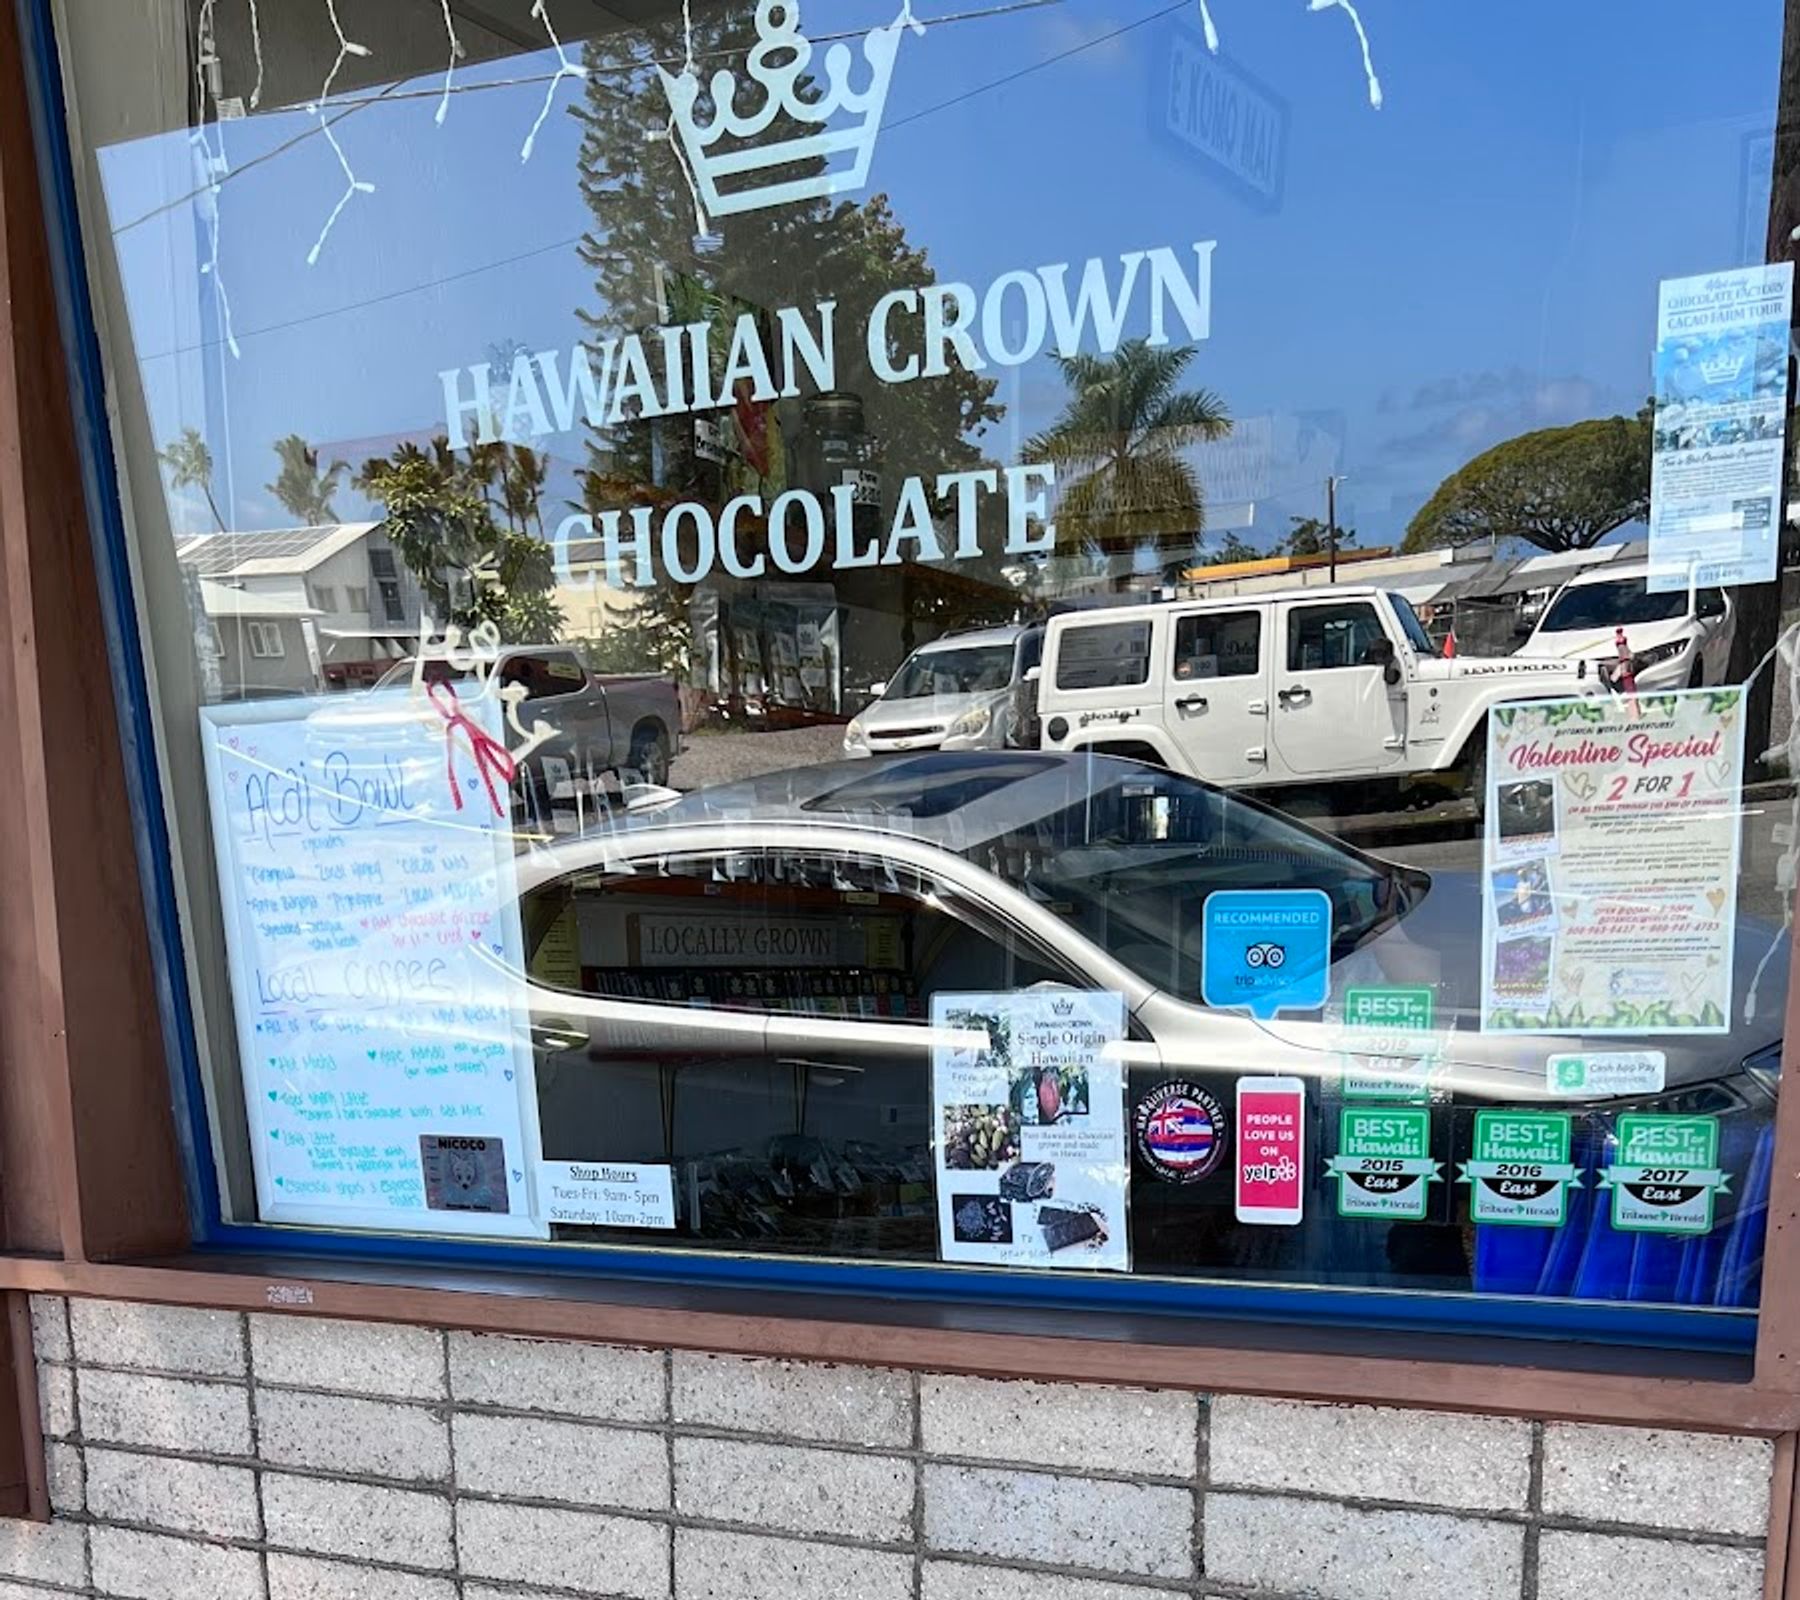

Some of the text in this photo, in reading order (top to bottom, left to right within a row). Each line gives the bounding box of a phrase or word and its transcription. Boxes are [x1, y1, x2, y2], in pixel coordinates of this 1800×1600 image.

[1667, 288, 1733, 310] CHOCOLATE
[1667, 301, 1783, 330] CACAO FARM TOUR
[438, 240, 1218, 452] HAWAIIAN CROWN
[554, 463, 1057, 591] CHOCOLATE
[1508, 731, 1722, 771] Valentine Special
[1606, 771, 1695, 802] 2 FOR 1
[1213, 911, 1321, 926] RECOMMENDED
[649, 925, 832, 956] LOCALLY GROWN
[1357, 997, 1413, 1017] BEST
[1017, 1029, 1107, 1049] Single Origin
[1031, 1050, 1094, 1065] Hawaiian
[1589, 1062, 1657, 1074] Cash App Pay
[1245, 1114, 1294, 1126] PEOPLE
[1353, 1118, 1409, 1139] BEST
[1244, 1129, 1295, 1142] LOVE US
[1489, 1121, 1545, 1143] BEST
[1631, 1125, 1695, 1148] BEST
[438, 1138, 487, 1152] NICOCO
[1259, 1145, 1279, 1157] ON
[1347, 1137, 1421, 1156] Hawaii
[1482, 1141, 1561, 1162] Hawaii
[1360, 1158, 1405, 1172] 2015
[1624, 1146, 1708, 1166] Hawaii
[569, 1165, 638, 1182] Shop Hours
[1244, 1163, 1281, 1184] yelp
[1495, 1164, 1543, 1178] 2016
[1637, 1168, 1690, 1184] 2017
[1363, 1174, 1400, 1190] East
[1499, 1179, 1538, 1196] East
[634, 1189, 660, 1206] 5pm
[1641, 1185, 1683, 1202] East
[1620, 1209, 1706, 1225] Tribune Herald
